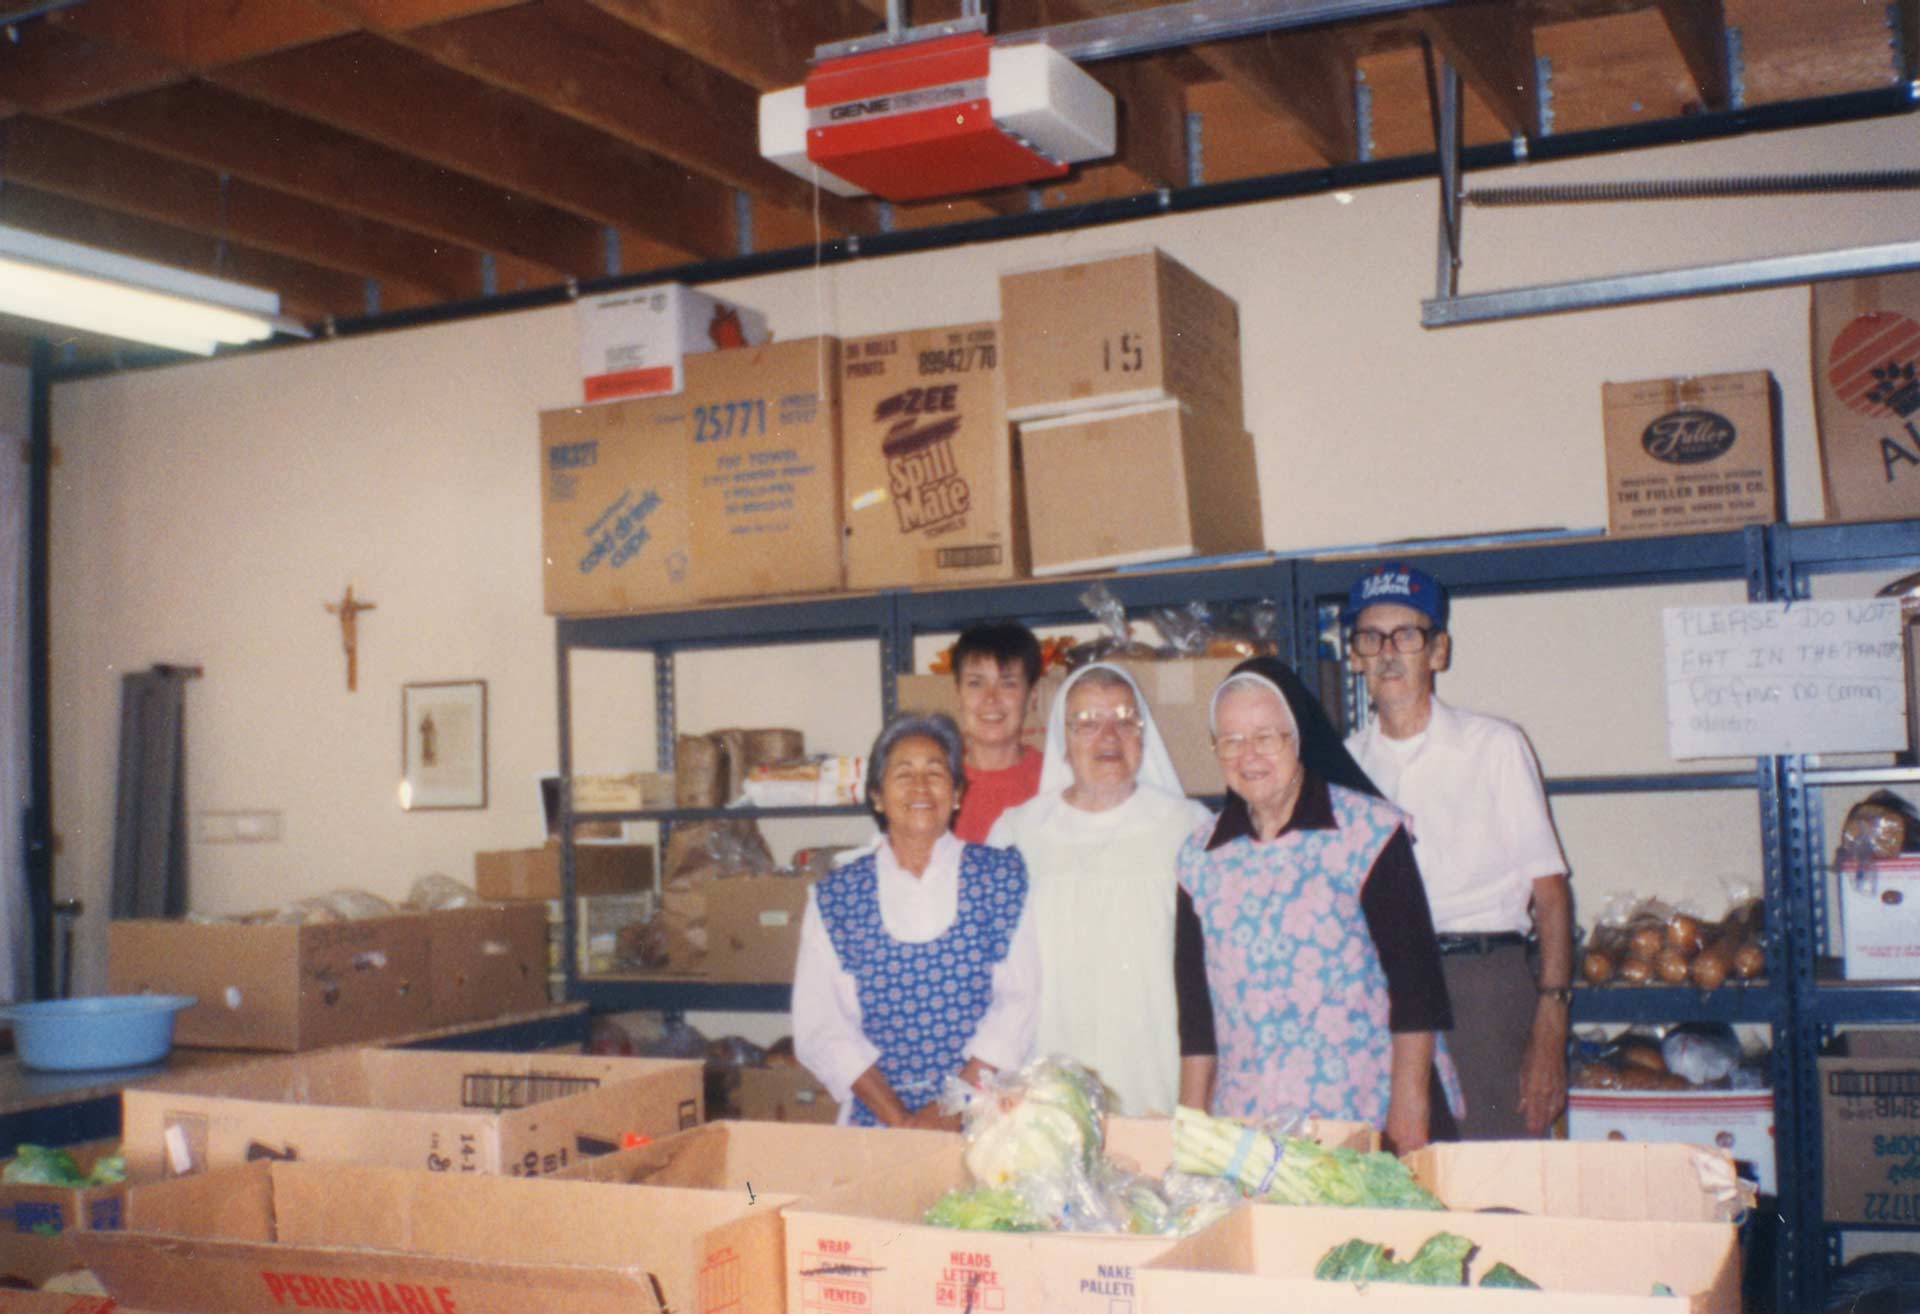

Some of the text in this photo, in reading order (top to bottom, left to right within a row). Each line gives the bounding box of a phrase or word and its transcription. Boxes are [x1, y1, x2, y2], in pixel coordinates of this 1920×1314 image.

[829, 97, 890, 121] GENIE
[1102, 333, 1142, 373] 15
[692, 398, 767, 442] 25771
[1650, 416, 1730, 456] Fuller
[888, 440, 958, 500] Spill
[892, 477, 970, 534] Mate
[1617, 490, 1639, 503] THE
[1646, 487, 1692, 500] FULLER
[1698, 483, 1741, 497] BRUSH
[1678, 602, 1898, 636] PLEASE DO NOT
[1681, 647, 1731, 674] EAT
[1746, 646, 1785, 670] IN
[1797, 643, 1840, 664] THE
[816, 1238, 852, 1254] WRAP
[950, 1250, 992, 1268] HEADS
[261, 1271, 457, 1314] PERISHABLE
[822, 1286, 867, 1305] VENTED
